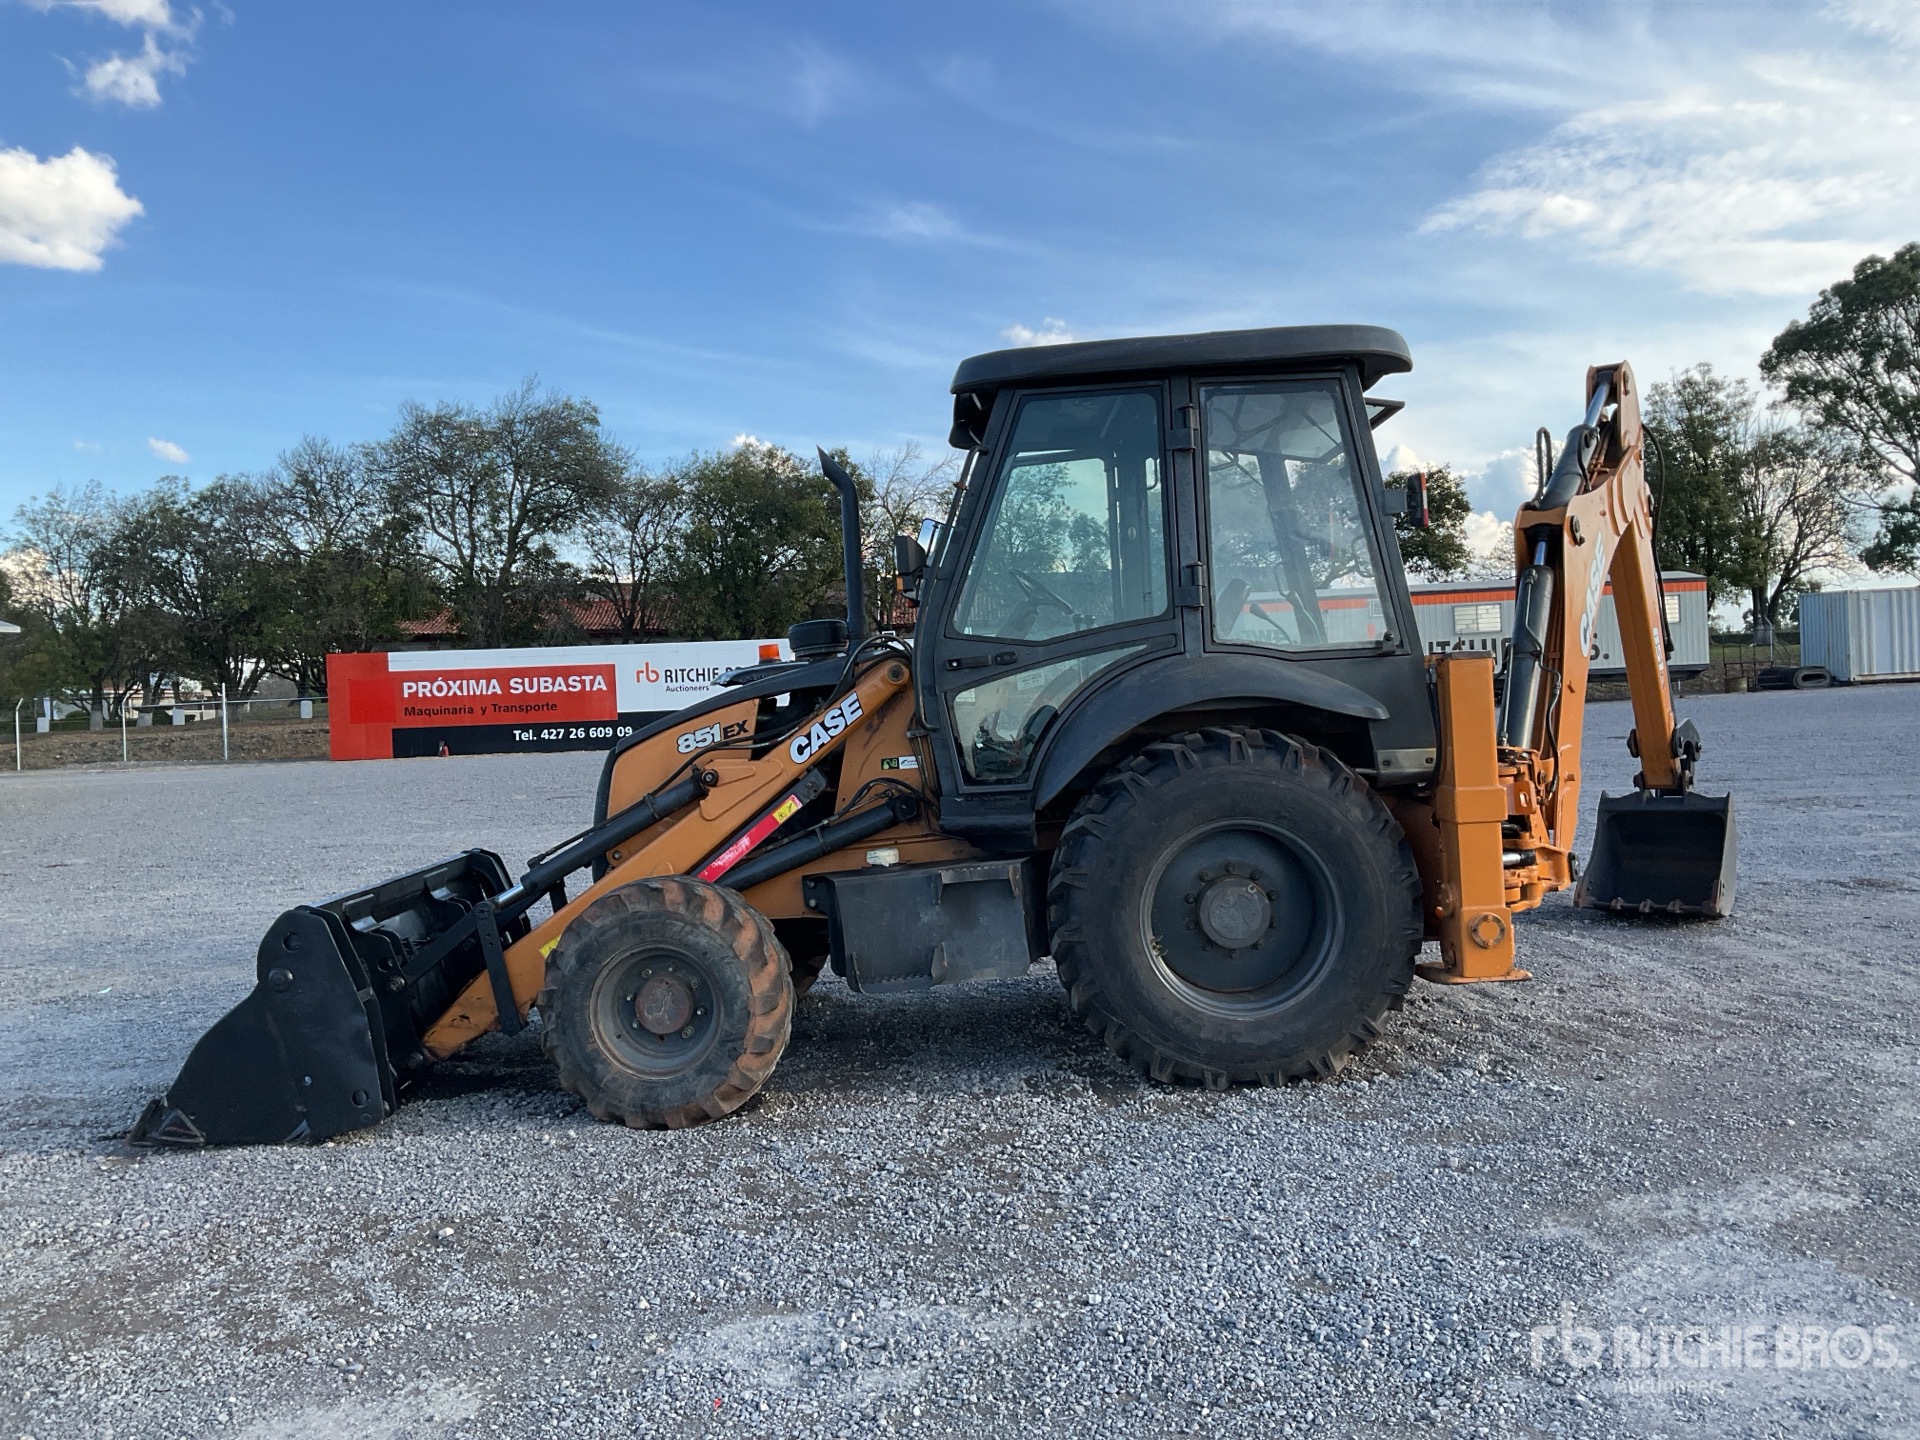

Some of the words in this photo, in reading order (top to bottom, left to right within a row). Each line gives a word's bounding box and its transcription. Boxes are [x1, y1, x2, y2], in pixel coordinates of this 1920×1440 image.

[664, 667, 719, 684] RITCHIE
[403, 677, 502, 698] PRÓXIMA
[509, 675, 608, 694] SUBASTA
[665, 684, 710, 693] Auctioneers
[404, 705, 474, 717] Maquinaria
[480, 706, 488, 716] y
[491, 702, 558, 714] Transporte
[513, 729, 537, 741] Tel.
[540, 728, 565, 740] 427
[569, 727, 586, 739] 26
[589, 726, 613, 738] 609
[616, 726, 633, 737] 09
[789, 691, 864, 764] CASE
[677, 722, 721, 754] 851
[722, 719, 750, 740] EX
